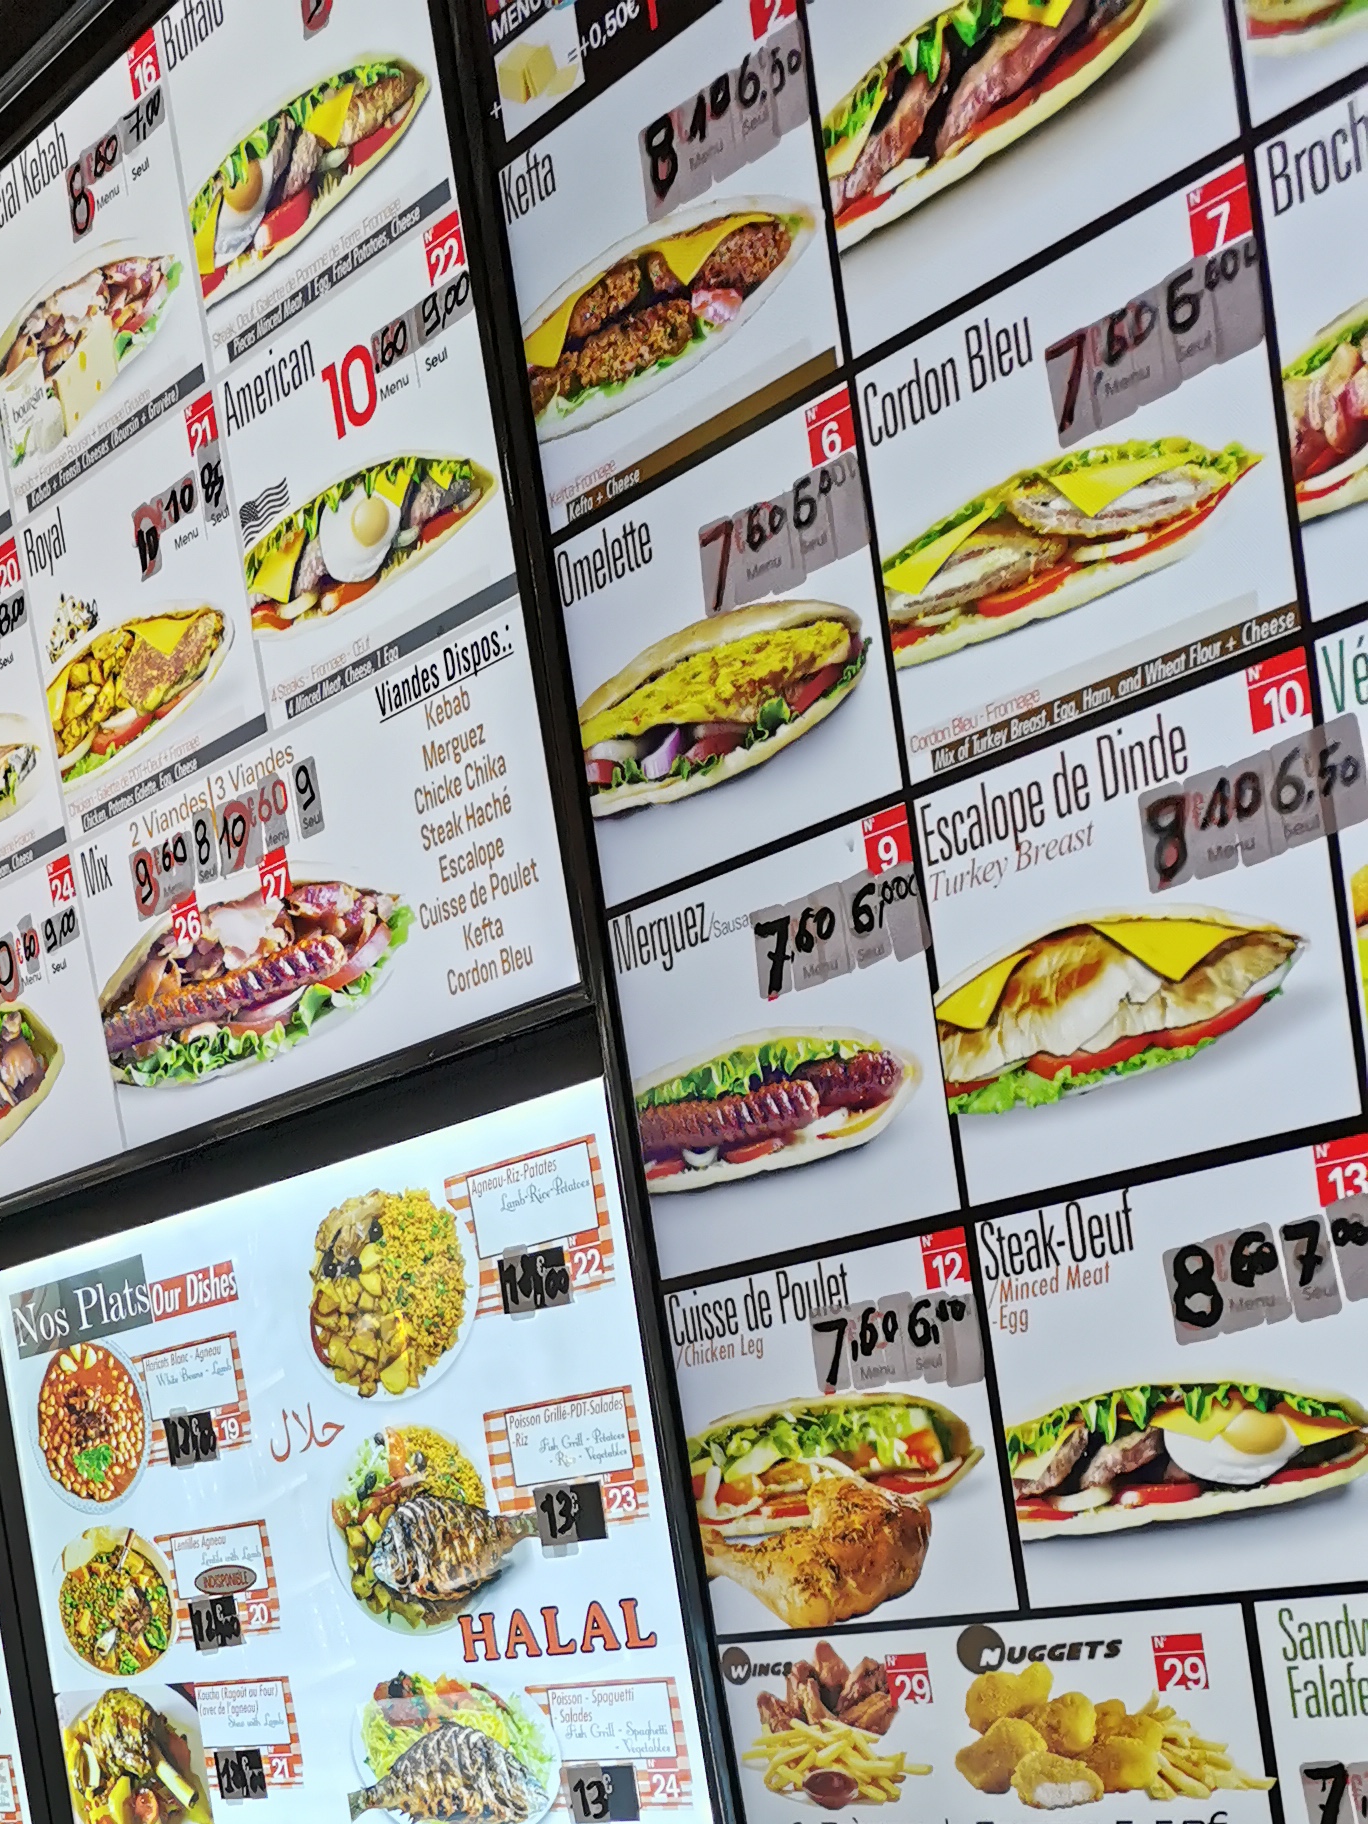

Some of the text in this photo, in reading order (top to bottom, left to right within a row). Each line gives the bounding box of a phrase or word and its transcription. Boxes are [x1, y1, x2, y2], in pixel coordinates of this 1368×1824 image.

[134, 55, 156, 93] 16
[19, 122, 69, 205] Kebab
[132, 157, 150, 181] Seul
[97, 184, 120, 212] Menu
[498, 150, 557, 225] Kefta
[391, 207, 421, 238] Cheese
[1205, 200, 1232, 252] 7
[430, 238, 459, 286] 22
[223, 339, 317, 438] American
[380, 347, 448, 401] Menu Seul
[862, 315, 1034, 448] Cordon Bleu
[192, 421, 215, 456] 21
[821, 421, 842, 459] 6
[606, 468, 641, 498] Cheese
[210, 505, 230, 527] Seul
[23, 506, 67, 577] Royal
[174, 527, 199, 550] Menu
[557, 520, 653, 608] Omelette
[0, 653, 14, 670] Seul
[376, 657, 440, 718] Viandes
[971, 726, 1010, 760] Turkey
[1144, 655, 1187, 688] Wheat
[1189, 640, 1222, 670] Flour
[1241, 611, 1296, 648] Cheese
[424, 685, 471, 731] Kebab
[422, 722, 486, 774] Merguez
[226, 742, 295, 794] Viandes
[414, 752, 508, 816] Chicke Chika
[920, 772, 1046, 868] Escalope
[1052, 750, 1090, 816] de
[1097, 712, 1189, 803] Dinde
[140, 788, 208, 837] Viandes
[420, 786, 512, 852] Steak Haché
[80, 844, 112, 899] Mix
[438, 833, 505, 884] Escalope
[879, 835, 899, 872] 9
[929, 820, 1095, 903] Turkey Breast
[50, 870, 75, 902] 24
[262, 870, 287, 901] 27
[419, 858, 540, 931] Cuisse de Poulet
[175, 914, 201, 943] 26
[462, 911, 505, 951] Kefta
[51, 957, 68, 975] Seul
[447, 942, 534, 997] Cordon Bleu
[980, 1187, 1134, 1281] Steak-Oeuf
[573, 1247, 603, 1281] 22
[932, 1253, 963, 1288] 12
[1066, 1260, 1111, 1291] Meat
[12, 1266, 238, 1348] Nos Plats Our Dishes
[668, 1261, 849, 1348] Cuisse de Poulet
[145, 1344, 222, 1372] Haricots Blanc Agneau
[740, 1333, 764, 1359] Leg
[220, 1418, 240, 1441] 19
[270, 1402, 345, 1463] حلال
[509, 1411, 542, 1430] Poisson
[607, 1488, 637, 1516] 23
[201, 1534, 227, 1549] Agneau
[248, 1603, 269, 1626] 20
[458, 1598, 658, 1664] HALAL
[979, 1638, 1123, 1668] NUGGETS
[895, 1673, 932, 1705] 29
[1163, 1656, 1208, 1692] 29
[197, 1688, 221, 1702] Koucha
[259, 1684, 279, 1700] Four)
[198, 1703, 218, 1718] (avec
[550, 1687, 636, 1708] Poisson Spaguetti
[560, 1706, 594, 1726] Salades
[624, 1719, 669, 1740] Spaghetti
[624, 1739, 672, 1755] Vegetables
[271, 1756, 290, 1779] 21
[651, 1773, 681, 1799] 24
